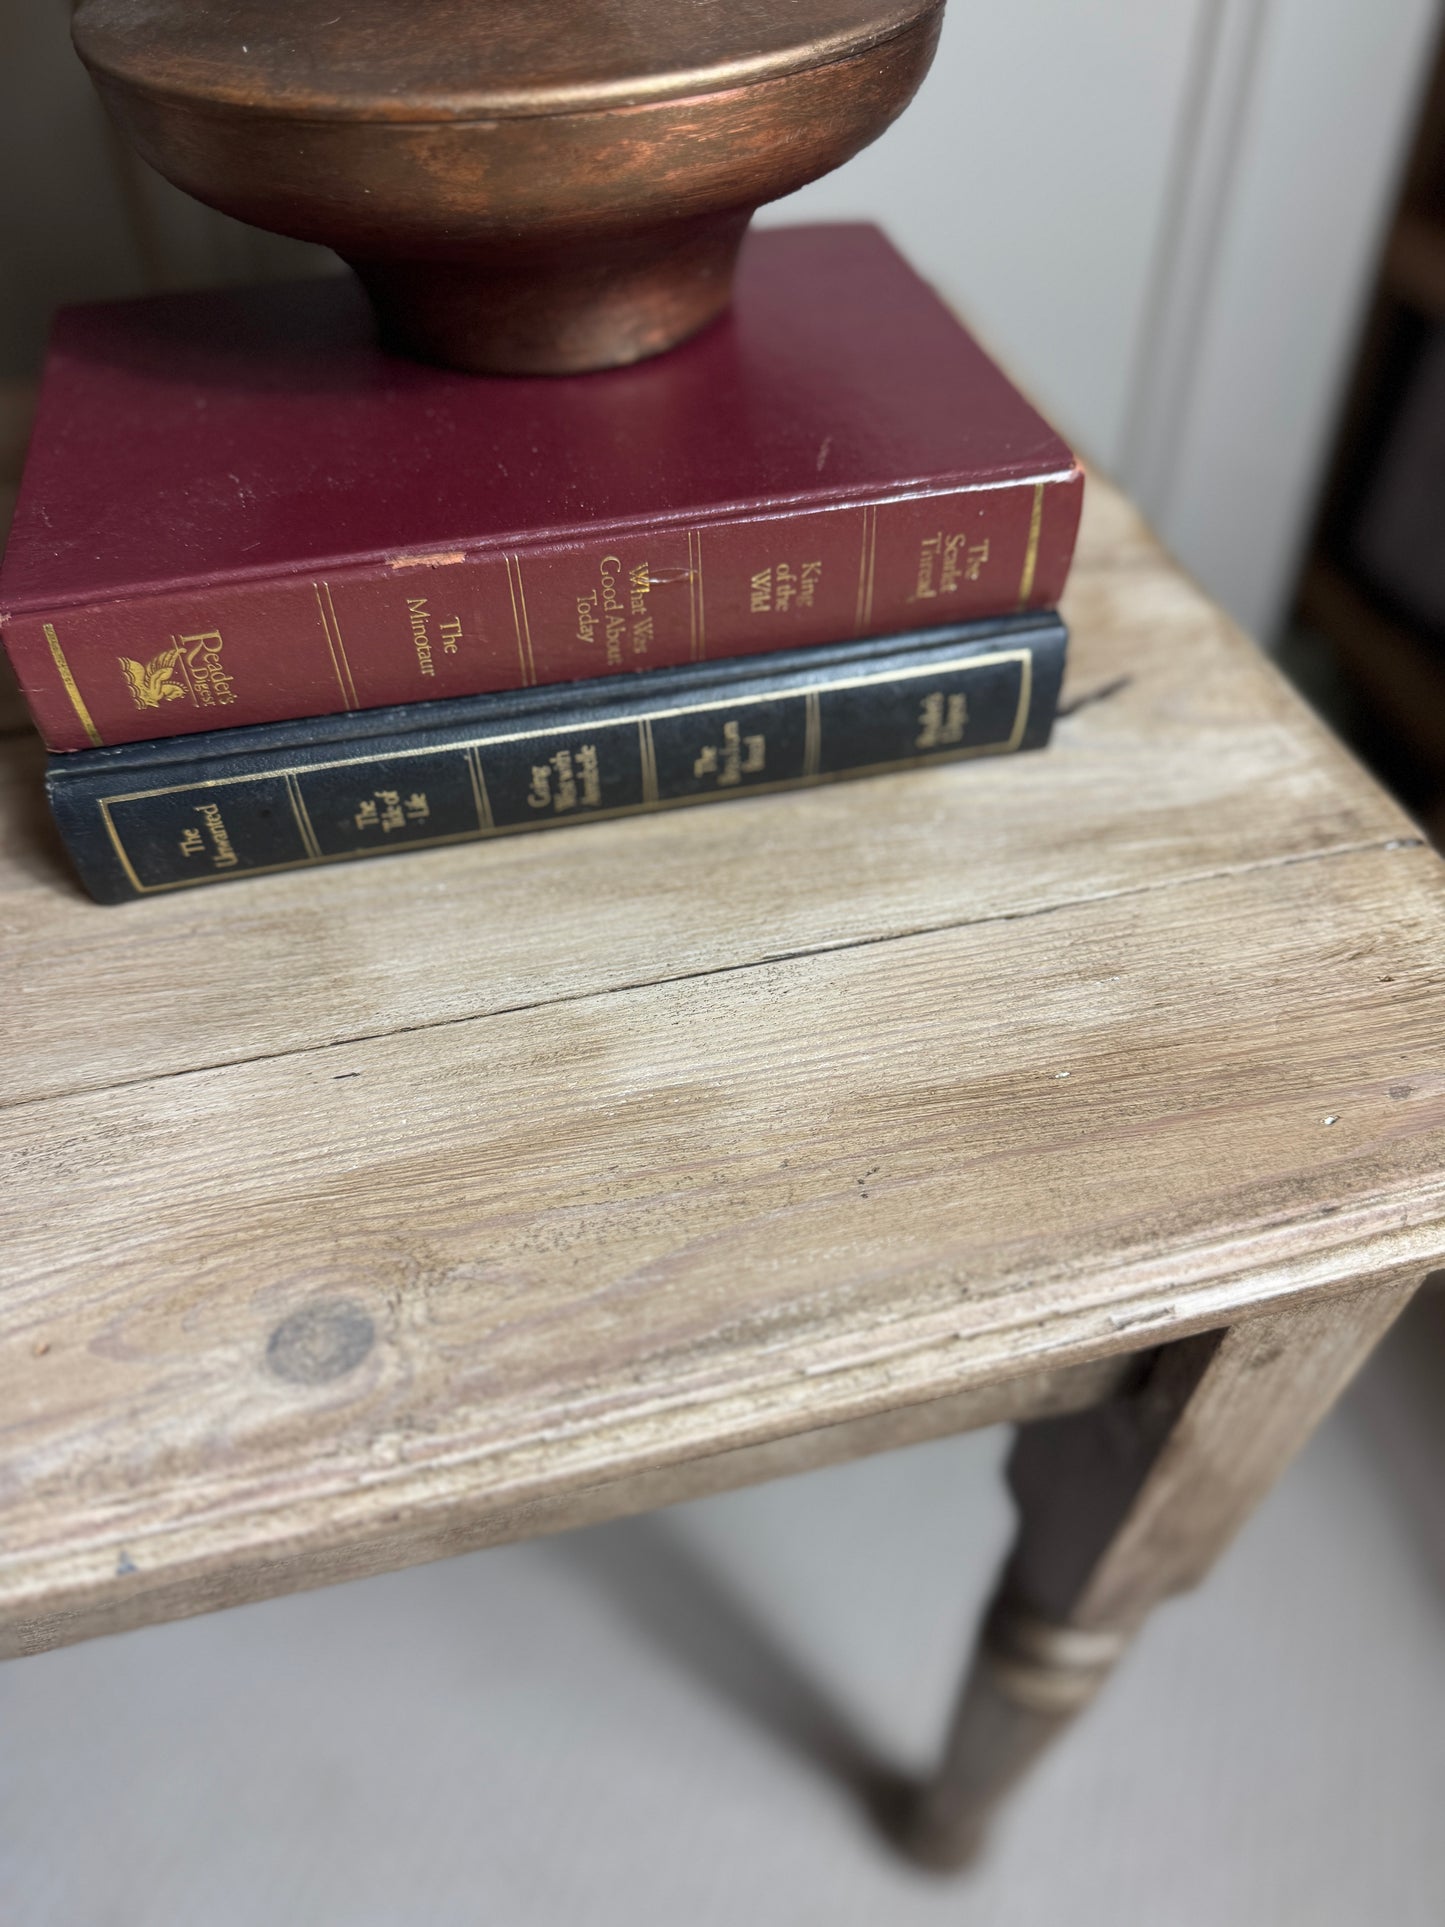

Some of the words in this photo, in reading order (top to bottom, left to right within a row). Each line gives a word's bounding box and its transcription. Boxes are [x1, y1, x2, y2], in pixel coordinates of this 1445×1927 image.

[776, 563, 797, 581] of
[965, 538, 989, 580] The
[600, 556, 624, 611] Good
[629, 561, 650, 615] What
[751, 566, 771, 613] Wild
[776, 585, 796, 612] the
[796, 561, 822, 607] King
[406, 599, 435, 677] Minotaur
[440, 616, 463, 654] The
[576, 589, 599, 643] Today
[605, 615, 626, 666] About
[180, 629, 237, 705] Reader's
[191, 667, 216, 706] Digest
[194, 803, 239, 868] Unwanted
[355, 800, 379, 830] The
[180, 828, 205, 857] The
